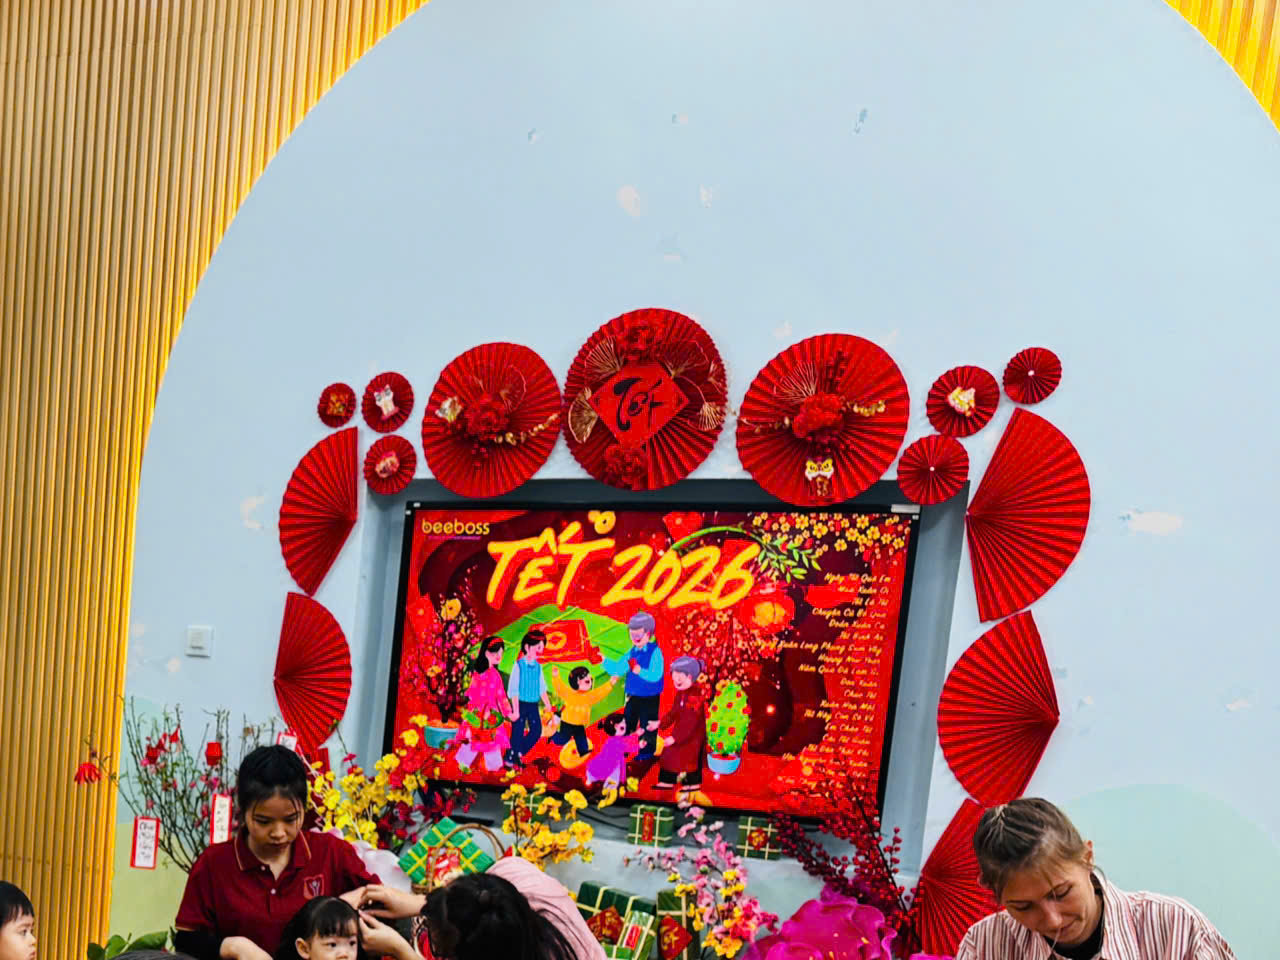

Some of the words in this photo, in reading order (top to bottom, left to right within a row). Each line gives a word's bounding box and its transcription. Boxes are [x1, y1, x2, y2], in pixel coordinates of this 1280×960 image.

[421, 519, 491, 536] beeboss
[487, 520, 616, 606] TẾT
[600, 543, 761, 609] 2026
